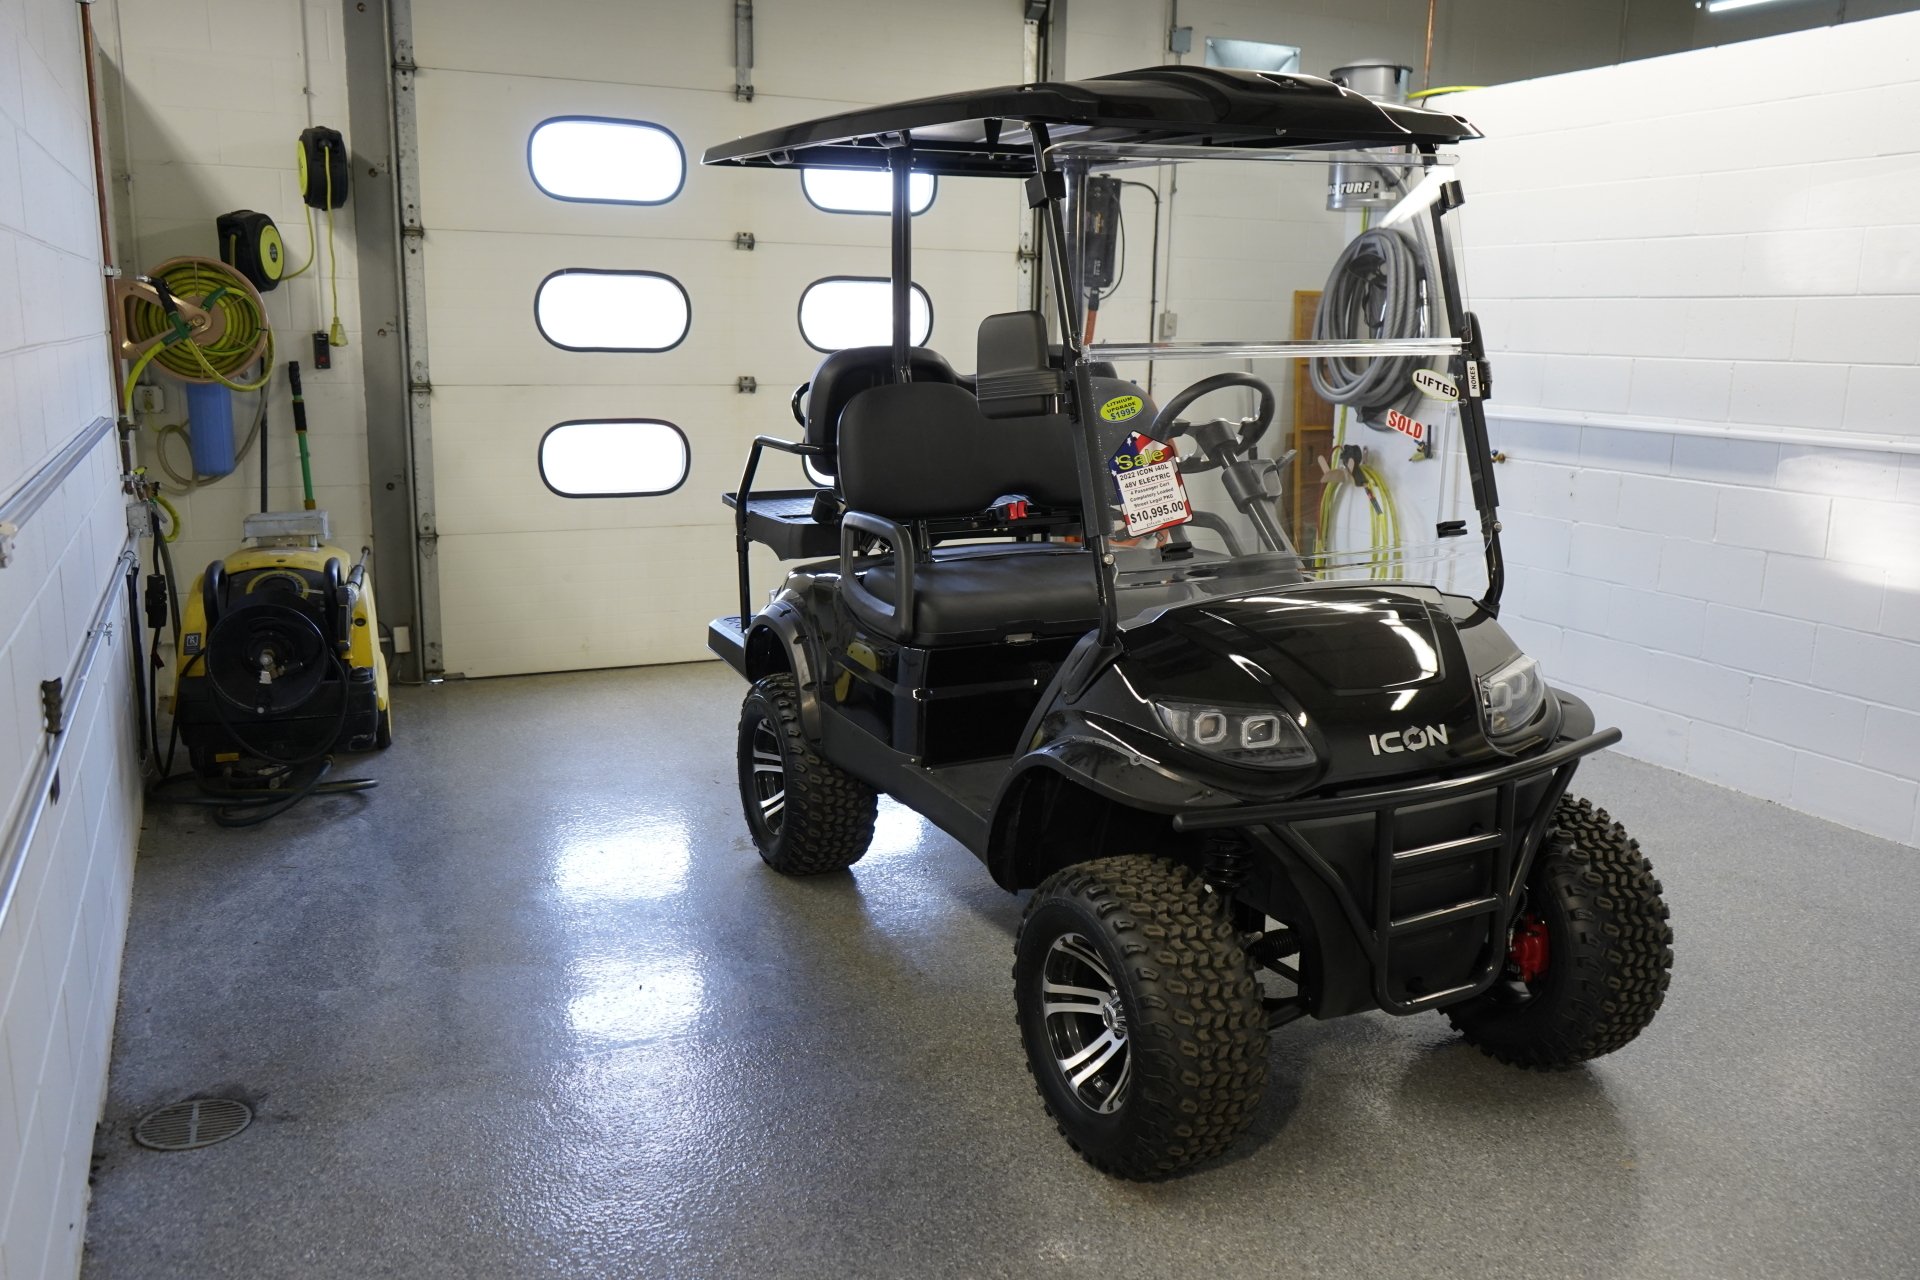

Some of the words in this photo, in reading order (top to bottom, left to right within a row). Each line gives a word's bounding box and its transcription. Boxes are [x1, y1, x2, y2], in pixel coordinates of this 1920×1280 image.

[1416, 372, 1457, 397] LIFTED
[1469, 366, 1477, 389] NOKES
[1106, 396, 1133, 407] LITHIUM
[1106, 401, 1136, 413] UPGRADE
[1110, 406, 1136, 420] $1995
[1388, 411, 1422, 439] SOLD
[1118, 449, 1165, 470] Sale
[1120, 472, 1136, 481] 2022
[1137, 467, 1154, 476] ICON
[1155, 463, 1169, 472] i40L
[1125, 481, 1137, 489] 48V
[1139, 472, 1171, 485] ELECTRIC
[1130, 492, 1156, 502] Completely
[1157, 487, 1174, 496] Loaded
[1135, 484, 1159, 494] Passenger
[1134, 500, 1149, 508] Street
[1150, 496, 1163, 504] Legal
[1130, 501, 1184, 524] $10,995.00
[1369, 723, 1449, 756] ICON
